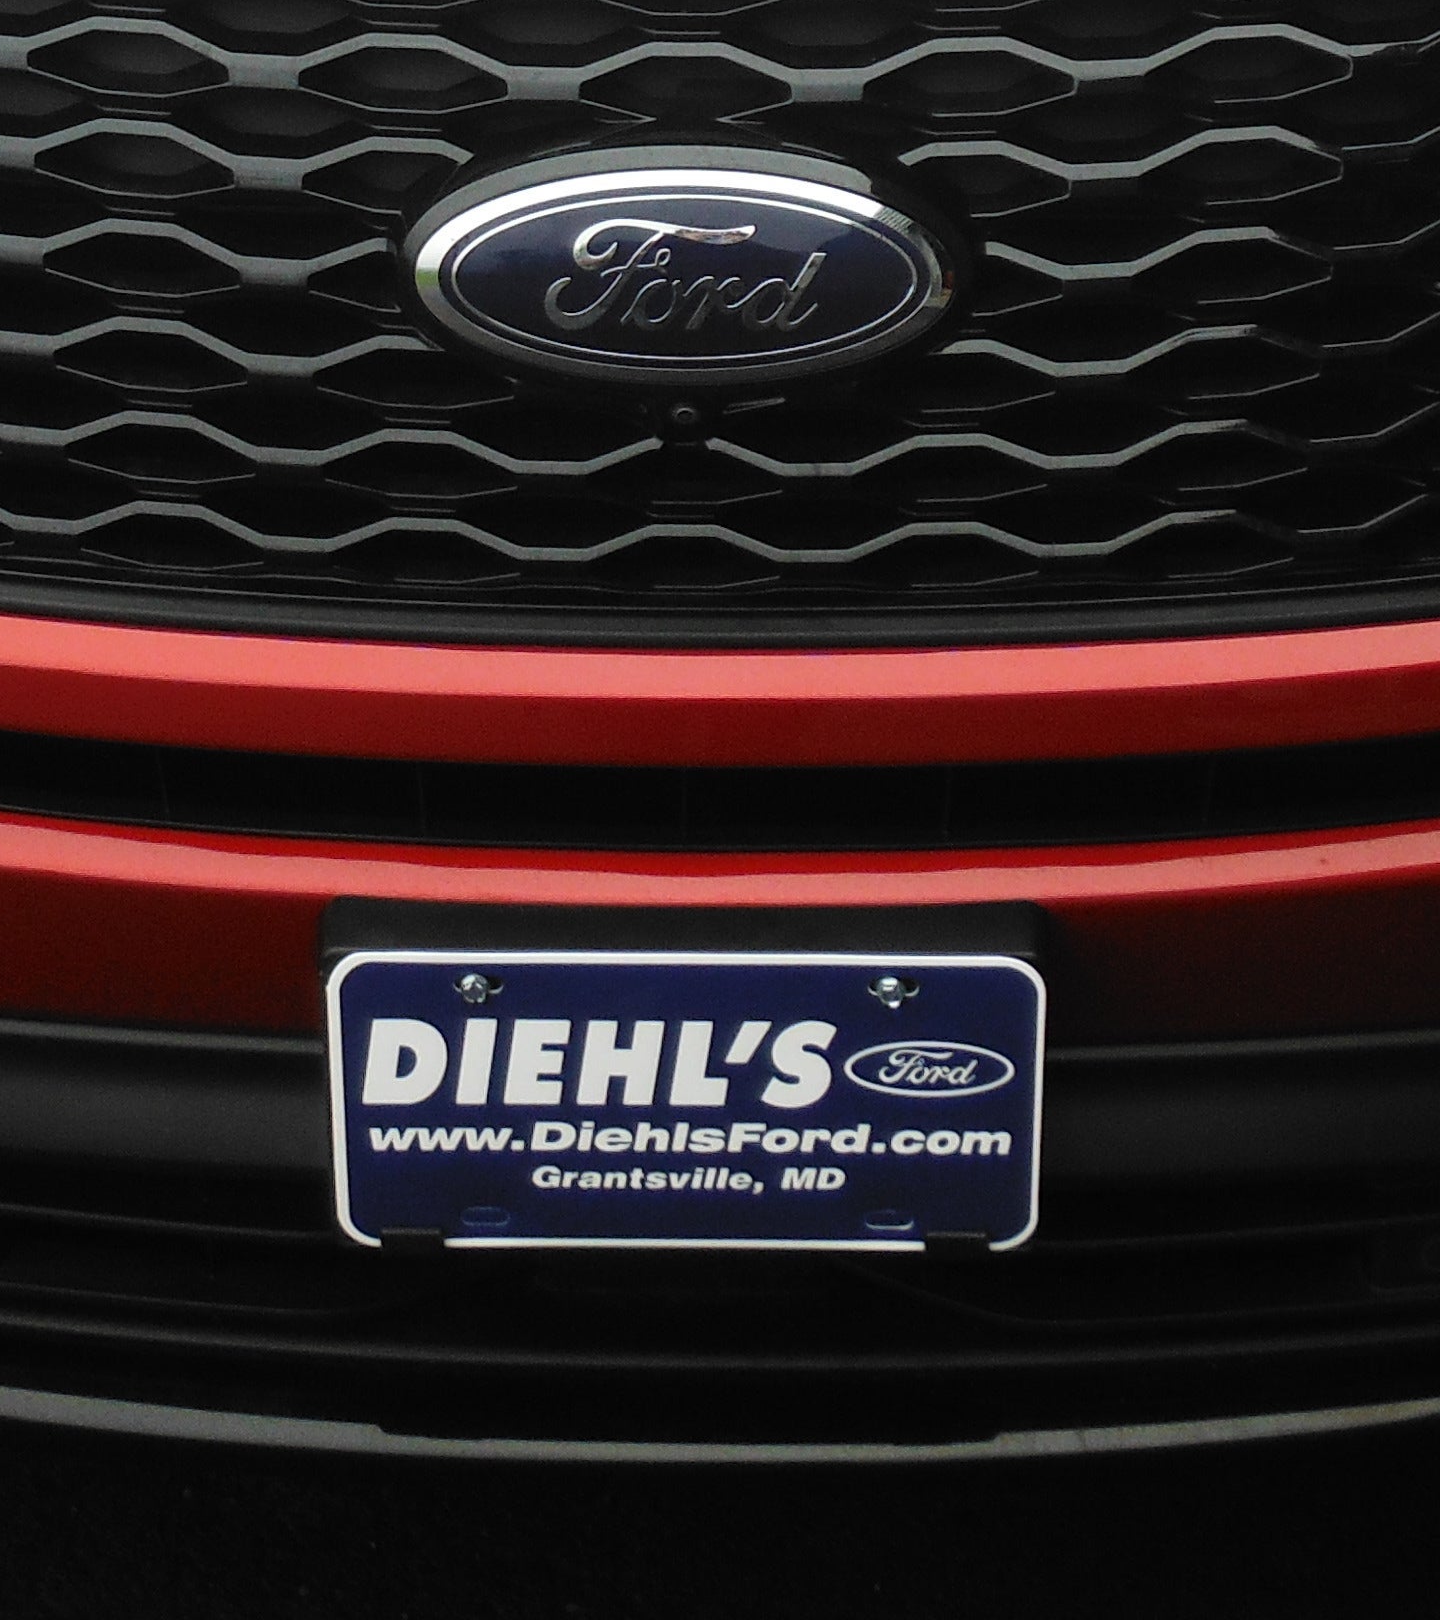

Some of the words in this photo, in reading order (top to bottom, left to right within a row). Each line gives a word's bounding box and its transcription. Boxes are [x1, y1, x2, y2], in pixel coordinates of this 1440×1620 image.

[544, 218, 827, 331] Ford
[361, 1017, 838, 1109] DIEHL'S
[877, 1051, 978, 1087] Ford
[368, 1120, 1013, 1156] www.DiehlsFord.com
[531, 1165, 764, 1195] Grantsville,
[780, 1166, 846, 1192] MD
